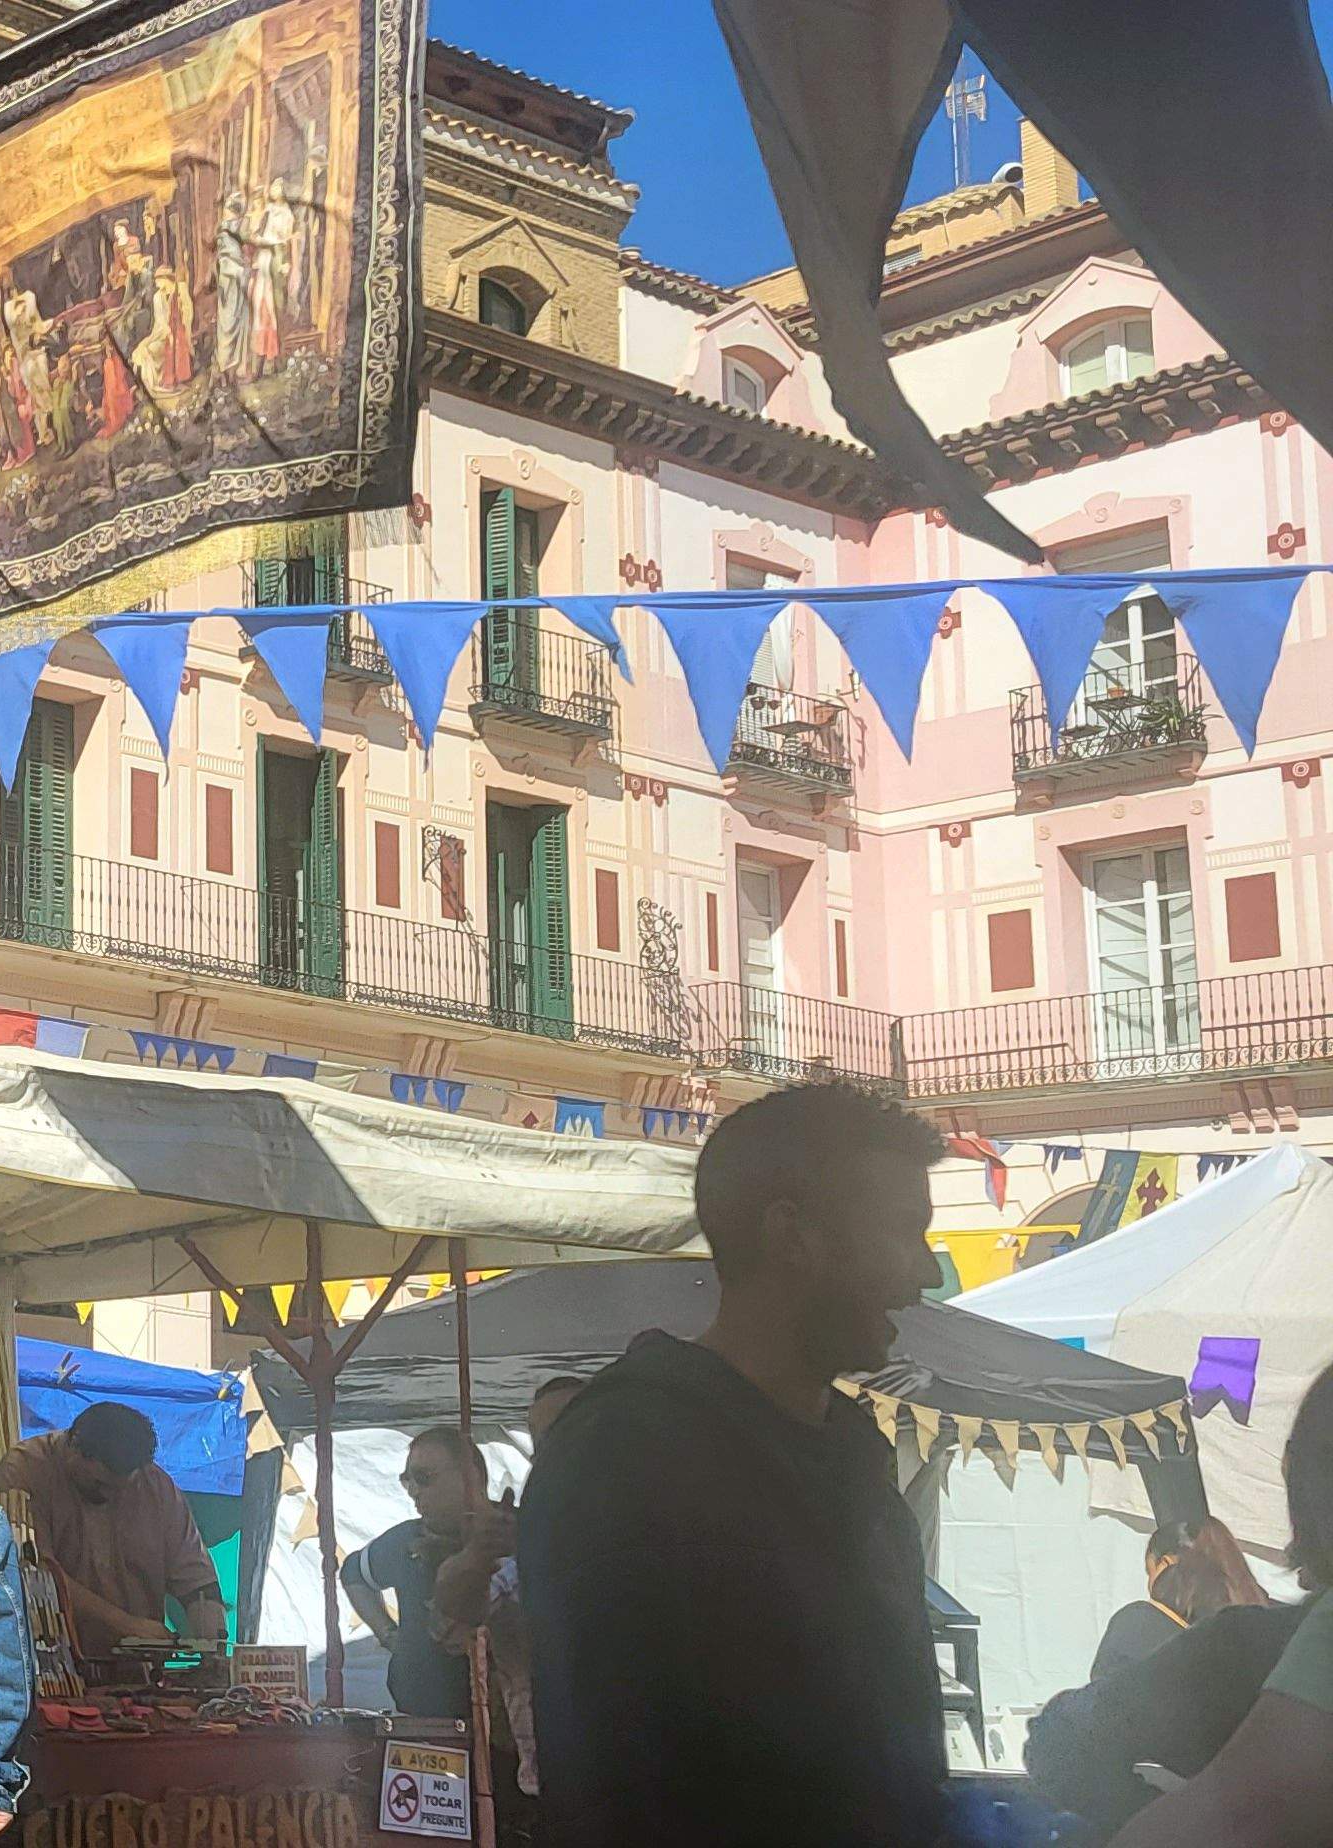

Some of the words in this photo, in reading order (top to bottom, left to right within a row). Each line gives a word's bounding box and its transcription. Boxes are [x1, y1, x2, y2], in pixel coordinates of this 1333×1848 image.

[409, 1752, 448, 1770] AVISO
[433, 1780, 449, 1791] NO
[424, 1795, 462, 1809] TOCAR
[188, 1791, 358, 1848] PALENCIA
[421, 1813, 465, 1828] PREGUNTE
